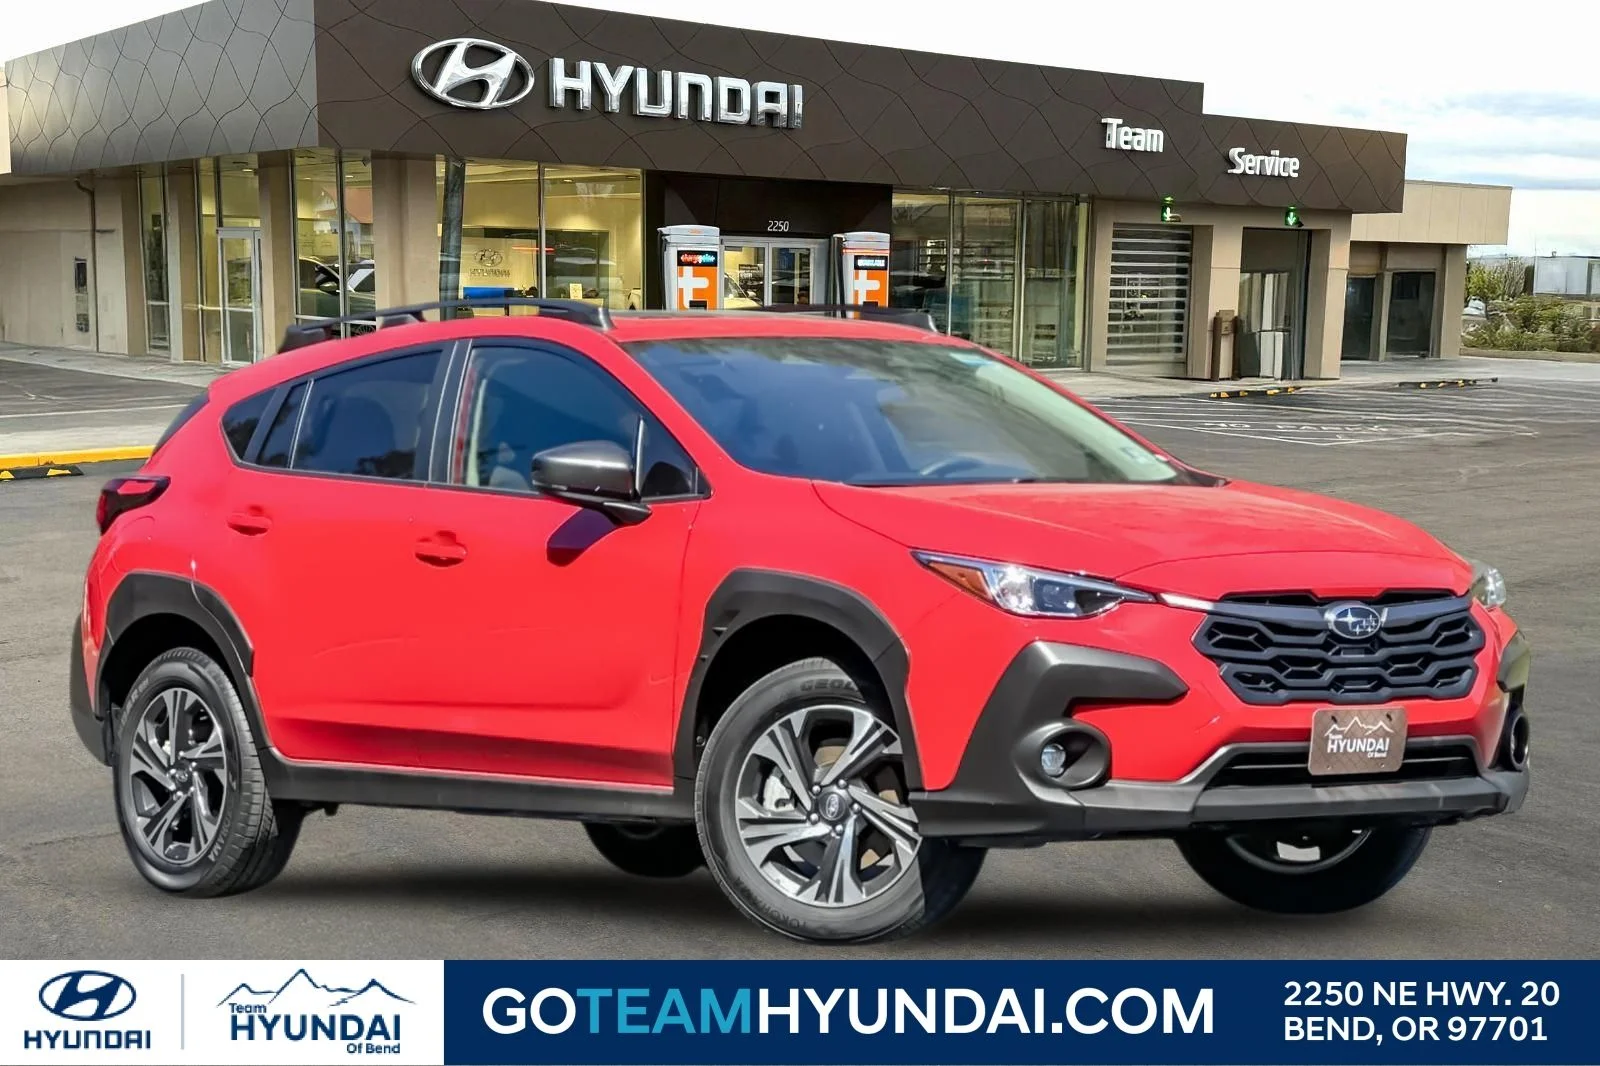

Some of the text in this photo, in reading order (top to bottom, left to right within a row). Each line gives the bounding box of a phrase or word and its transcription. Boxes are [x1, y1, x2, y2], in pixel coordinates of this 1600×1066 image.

[548, 57, 803, 129] HYUNDAI
[1101, 117, 1164, 153] Team
[1227, 147, 1300, 178] Service
[767, 219, 790, 232] 2250
[1327, 737, 1390, 754] HYUNDAI
